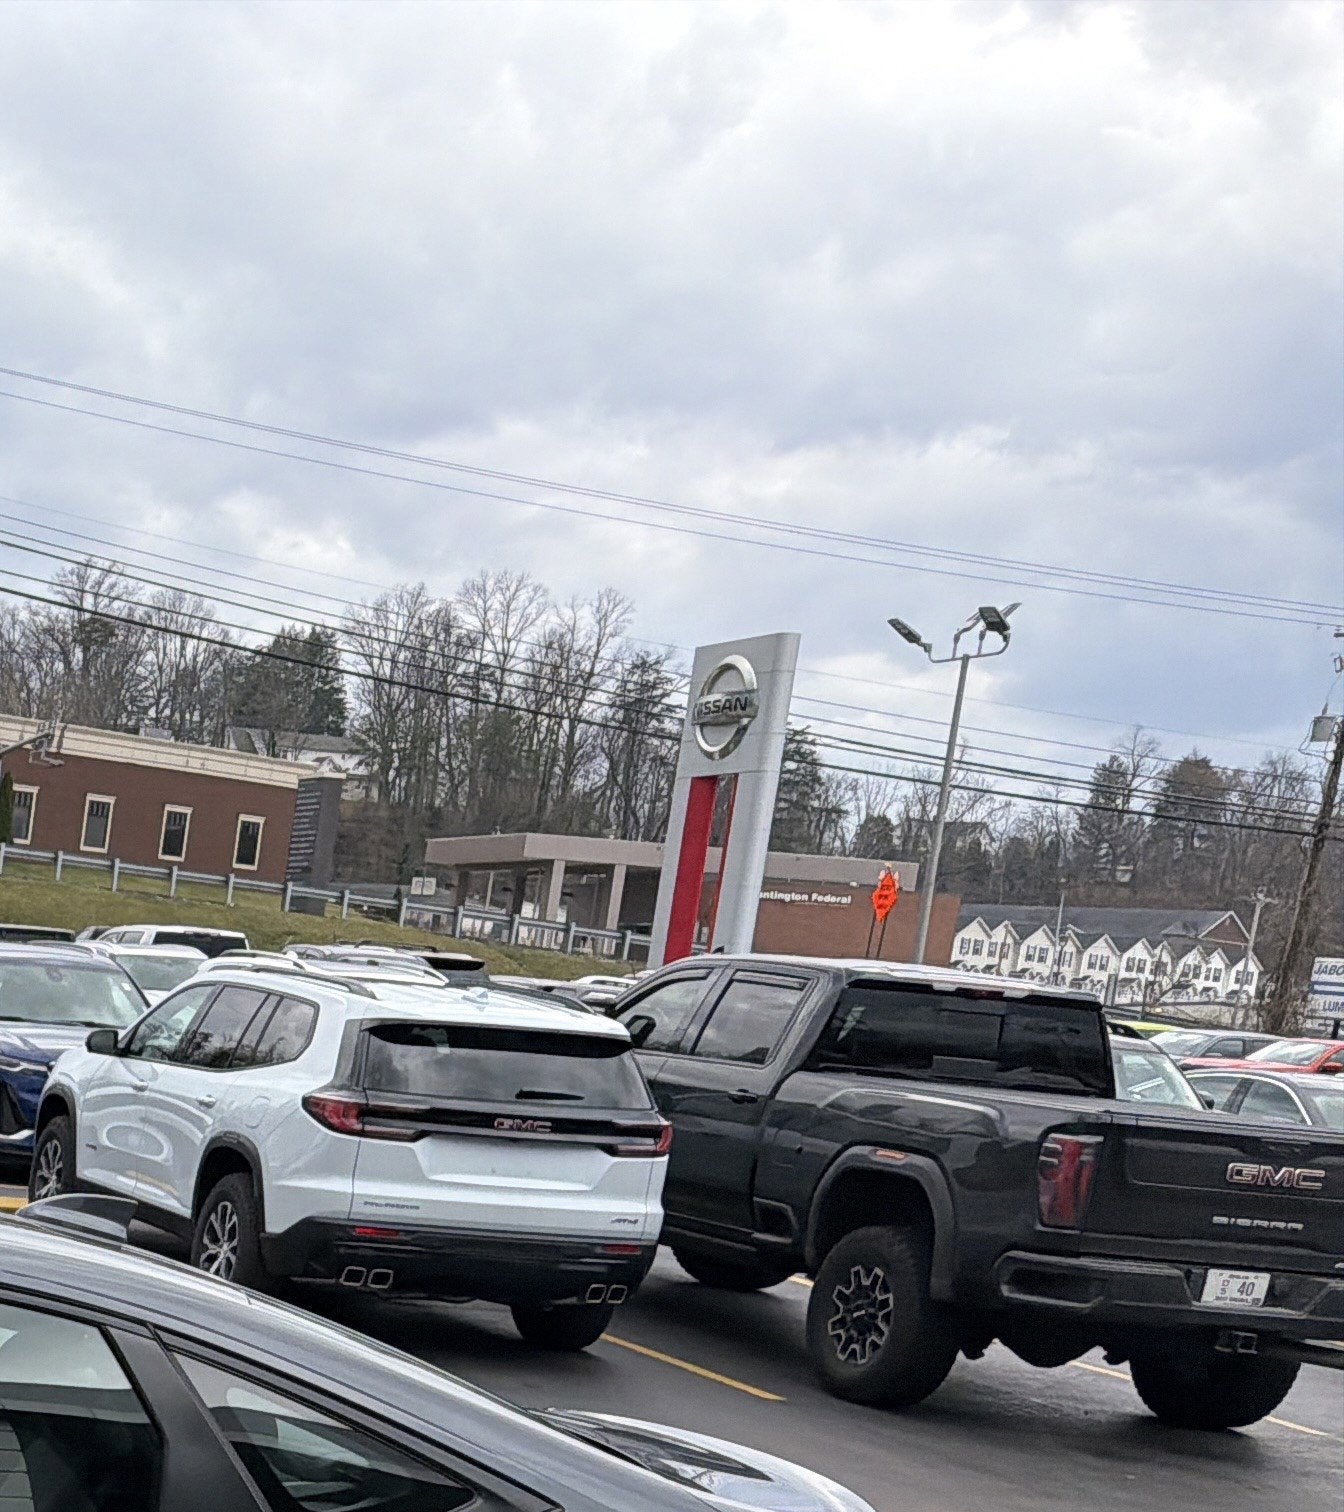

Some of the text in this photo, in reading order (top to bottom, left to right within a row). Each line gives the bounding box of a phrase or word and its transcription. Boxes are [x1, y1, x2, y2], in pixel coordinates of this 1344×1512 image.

[694, 696, 749, 718] NISSAN
[760, 890, 852, 904] untington Federal
[494, 1118, 552, 1133] GMC
[1225, 1162, 1326, 1190] GMC
[1212, 1216, 1304, 1231] SIERRA
[1237, 1281, 1256, 1297] 40
